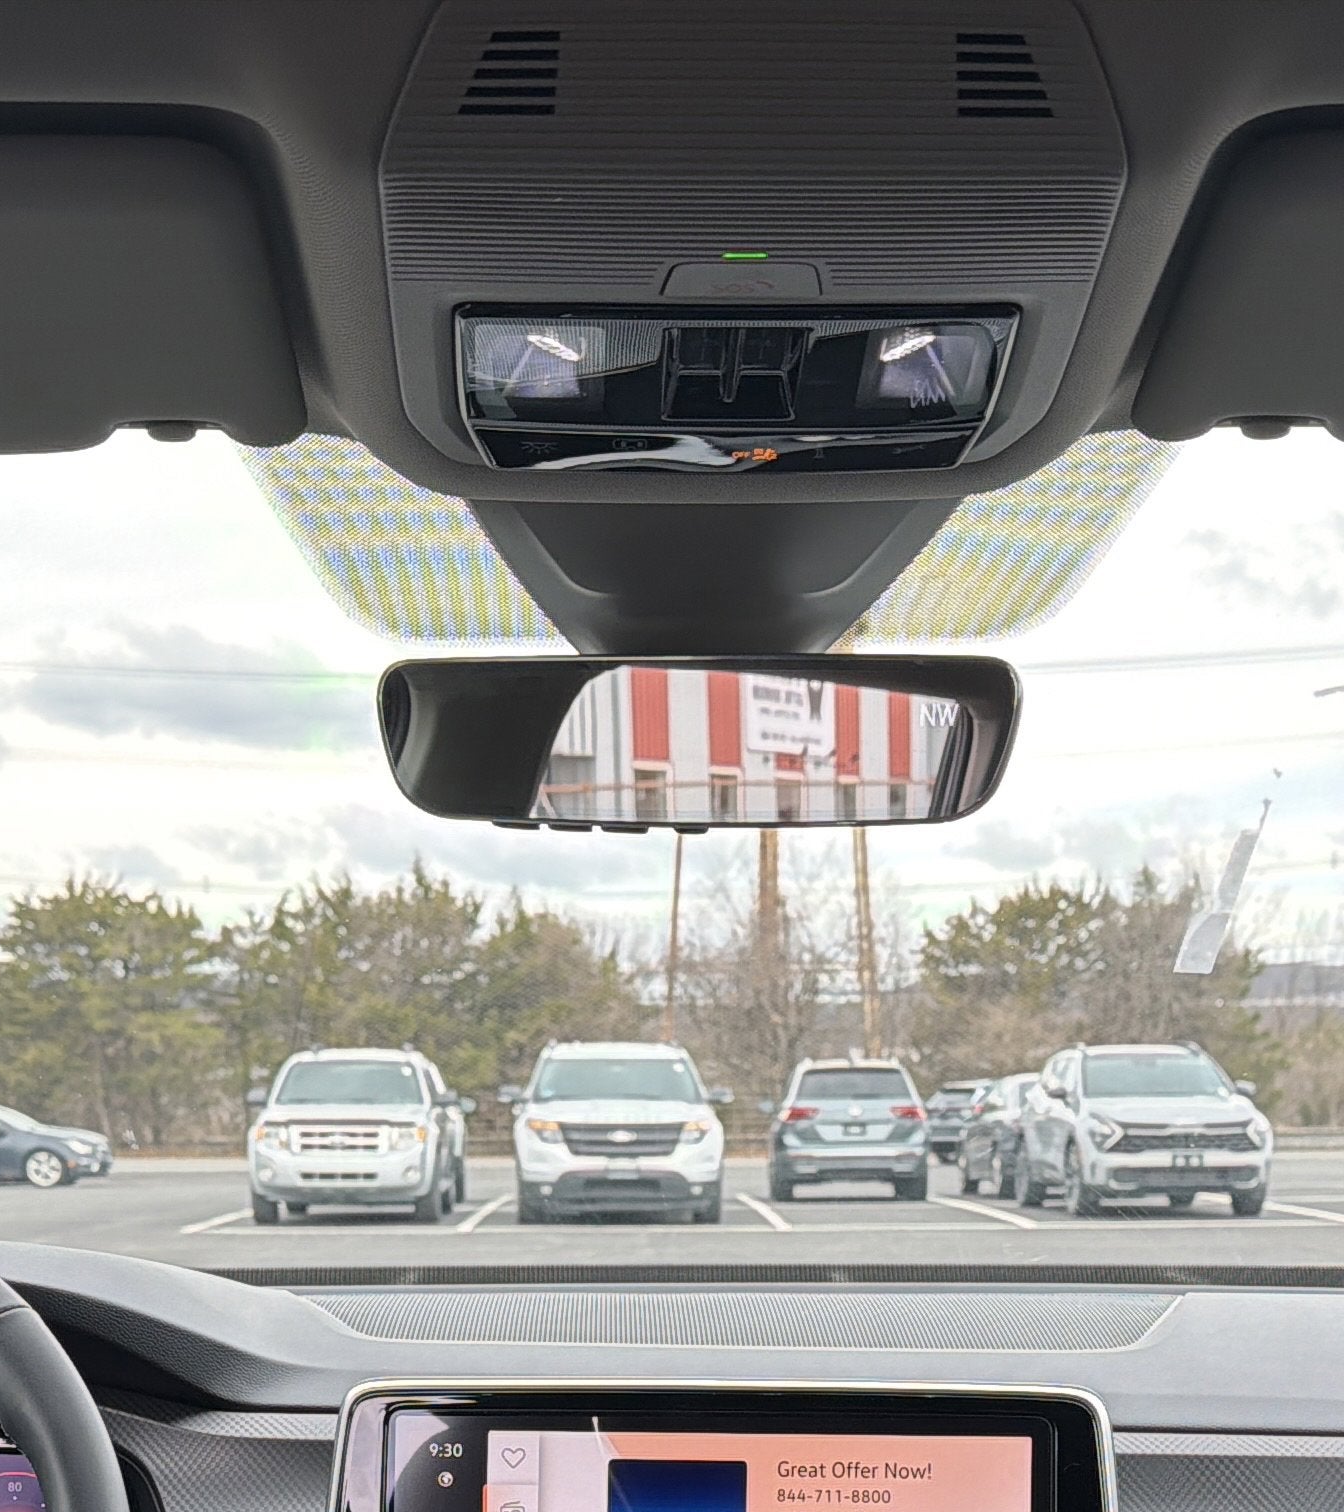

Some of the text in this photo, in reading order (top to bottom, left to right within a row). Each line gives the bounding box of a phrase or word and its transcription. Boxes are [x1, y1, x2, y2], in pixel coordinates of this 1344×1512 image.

[919, 702, 961, 728] NW
[429, 1443, 463, 1459] 9:30
[777, 1460, 933, 1480] Great Offer Now!
[7, 1481, 23, 1493] 80
[776, 1488, 892, 1504] 844-711-8800
